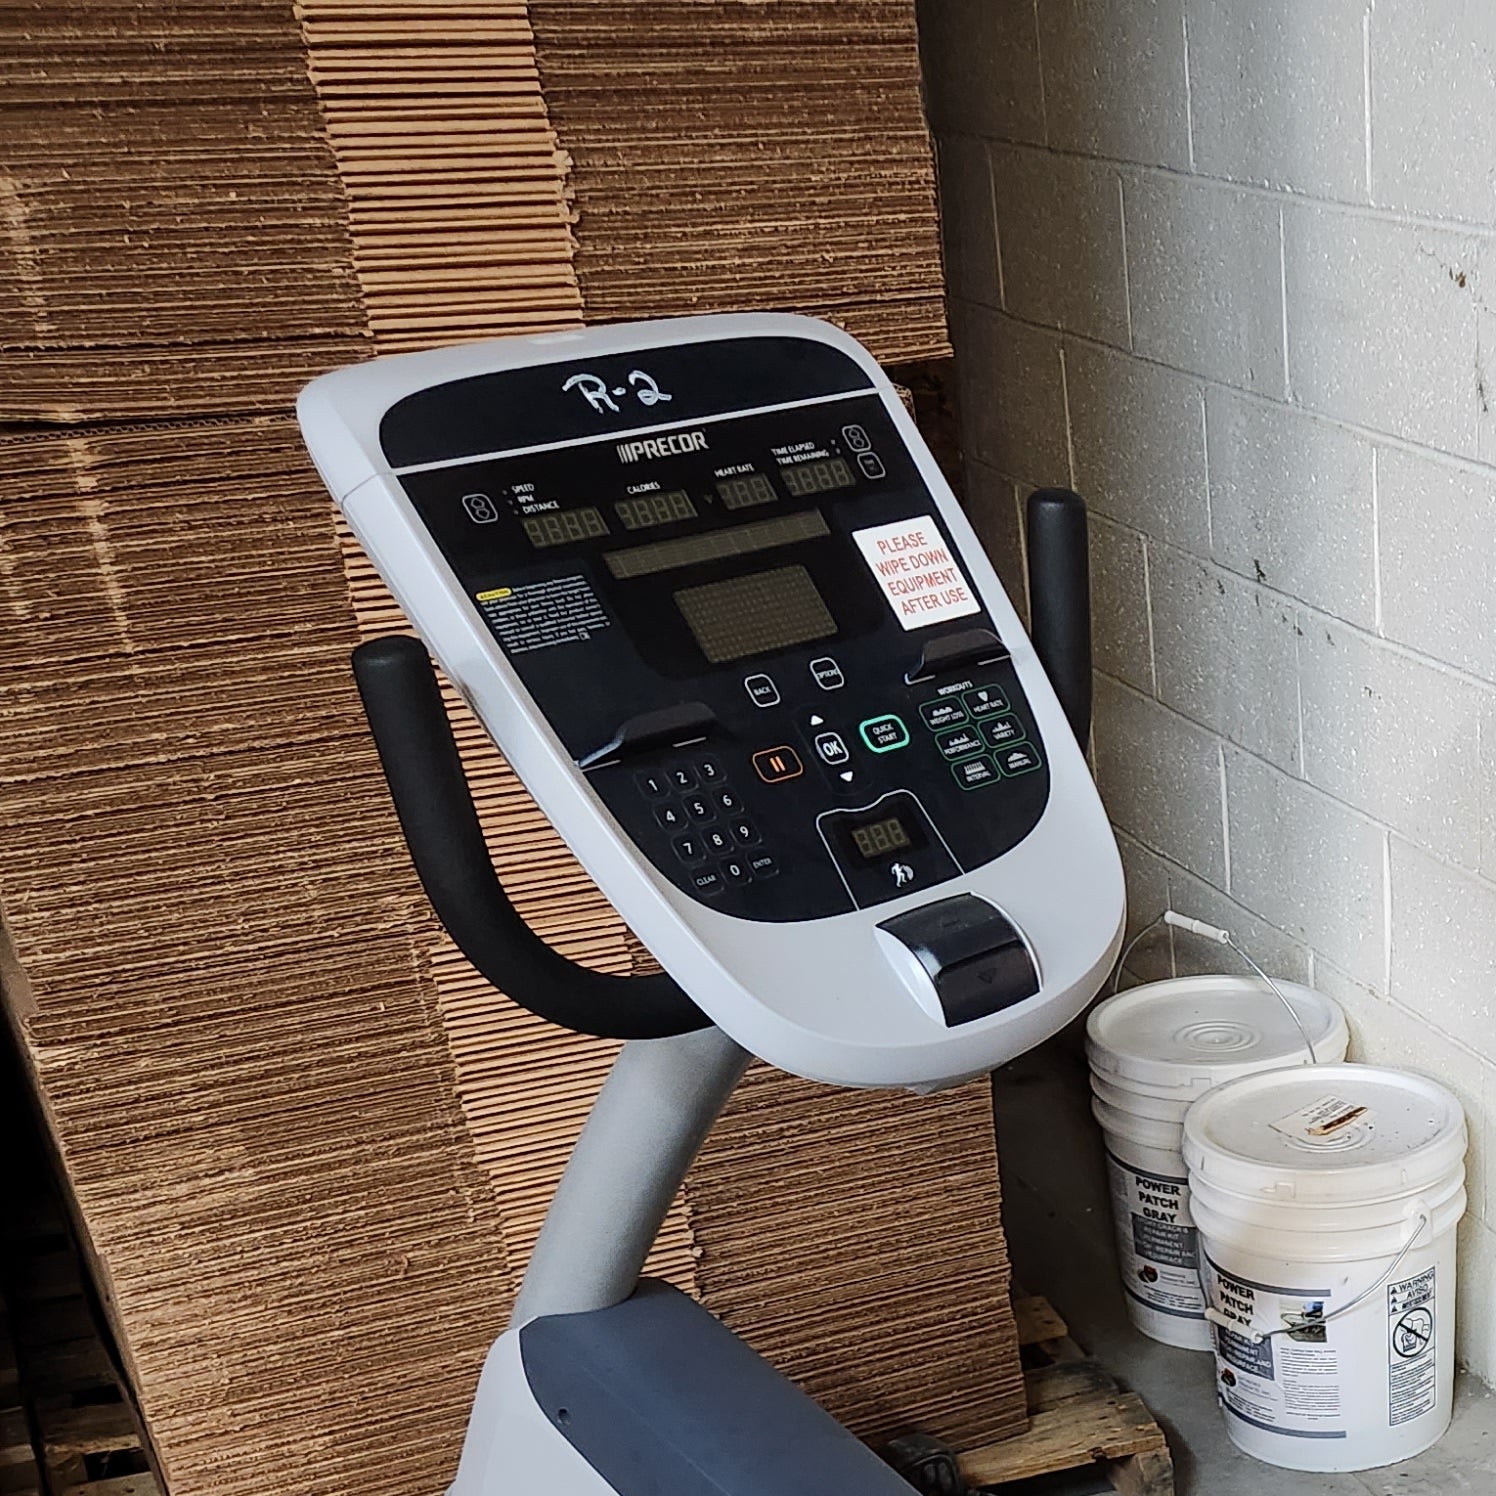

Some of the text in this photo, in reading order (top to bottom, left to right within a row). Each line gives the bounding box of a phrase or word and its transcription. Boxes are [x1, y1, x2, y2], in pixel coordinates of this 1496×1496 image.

[562, 370, 673, 414] R-2
[627, 431, 709, 462] PRECOR
[771, 441, 815, 457] TIME ELAPSED
[793, 449, 830, 463] REMAINING
[714, 463, 755, 478] HEART RATE
[511, 483, 535, 494] SPEED
[627, 481, 661, 494] CALORIES
[517, 494, 535, 504] RPM
[523, 500, 560, 514] DISTANCE
[876, 532, 928, 555] PLEASE
[875, 548, 949, 577] WIPE DOWN
[887, 568, 958, 596] EQUIPMENT
[901, 587, 968, 615] AFTER USE
[753, 686, 771, 696] BACK
[937, 680, 973, 696] WORKOUTS
[929, 713, 951, 725] WEIGHT
[872, 723, 894, 735] QUICK
[993, 729, 1016, 740] VARIETY
[877, 732, 898, 744] START
[823, 741, 843, 756] OK
[943, 739, 982, 755] PERFORMANCE
[648, 764, 715, 791] 1 2 3
[666, 794, 732, 822] 4 5 6
[682, 825, 749, 855] 7 8 9
[696, 857, 772, 886] CLEAR 0 ENTER
[1135, 1176, 1181, 1196] POWER
[1138, 1191, 1179, 1211] PATCH
[1142, 1207, 1177, 1224] GRAY
[1217, 1274, 1255, 1300] POWER
[1220, 1291, 1254, 1315] PATCH
